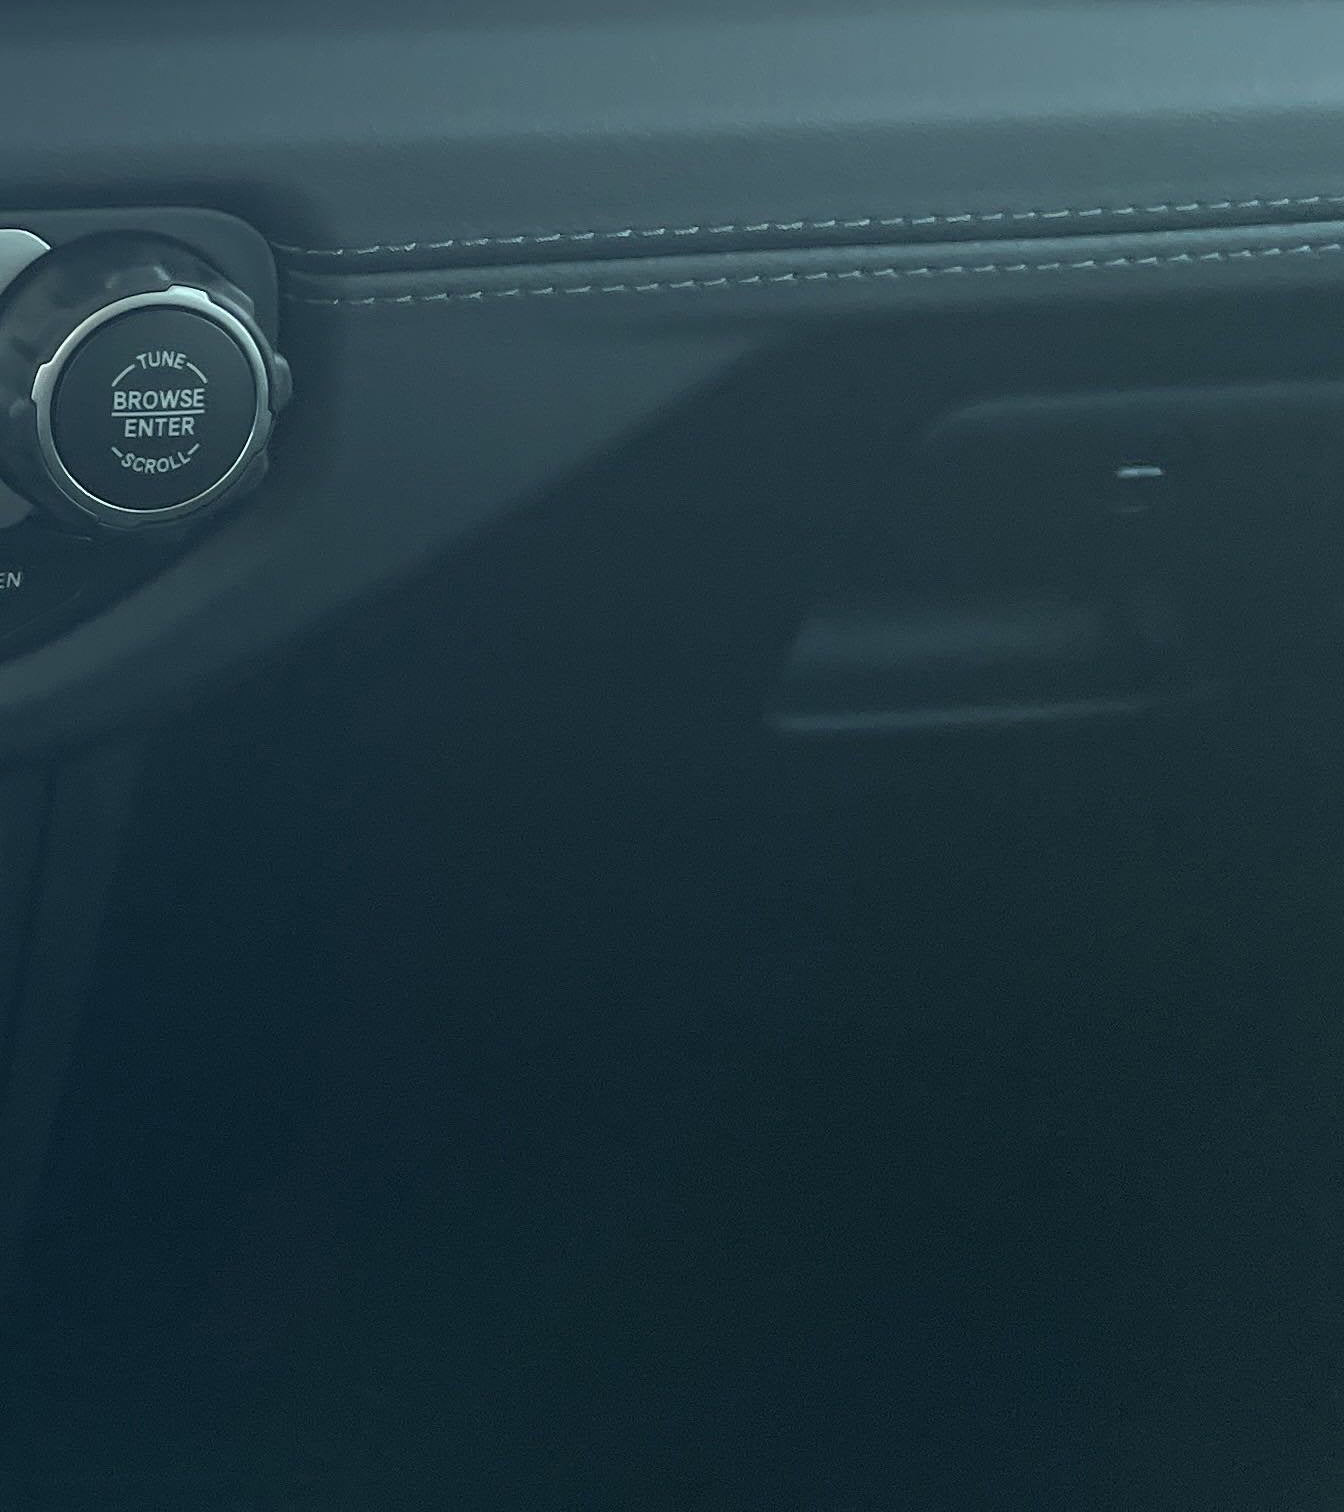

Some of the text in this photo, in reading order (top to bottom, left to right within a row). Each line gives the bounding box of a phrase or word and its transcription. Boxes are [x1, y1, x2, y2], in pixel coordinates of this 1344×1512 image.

[136, 351, 187, 371] TUNE
[112, 388, 206, 410] BROWSE
[124, 417, 195, 438] ENTER
[121, 449, 191, 473] SCROLL
